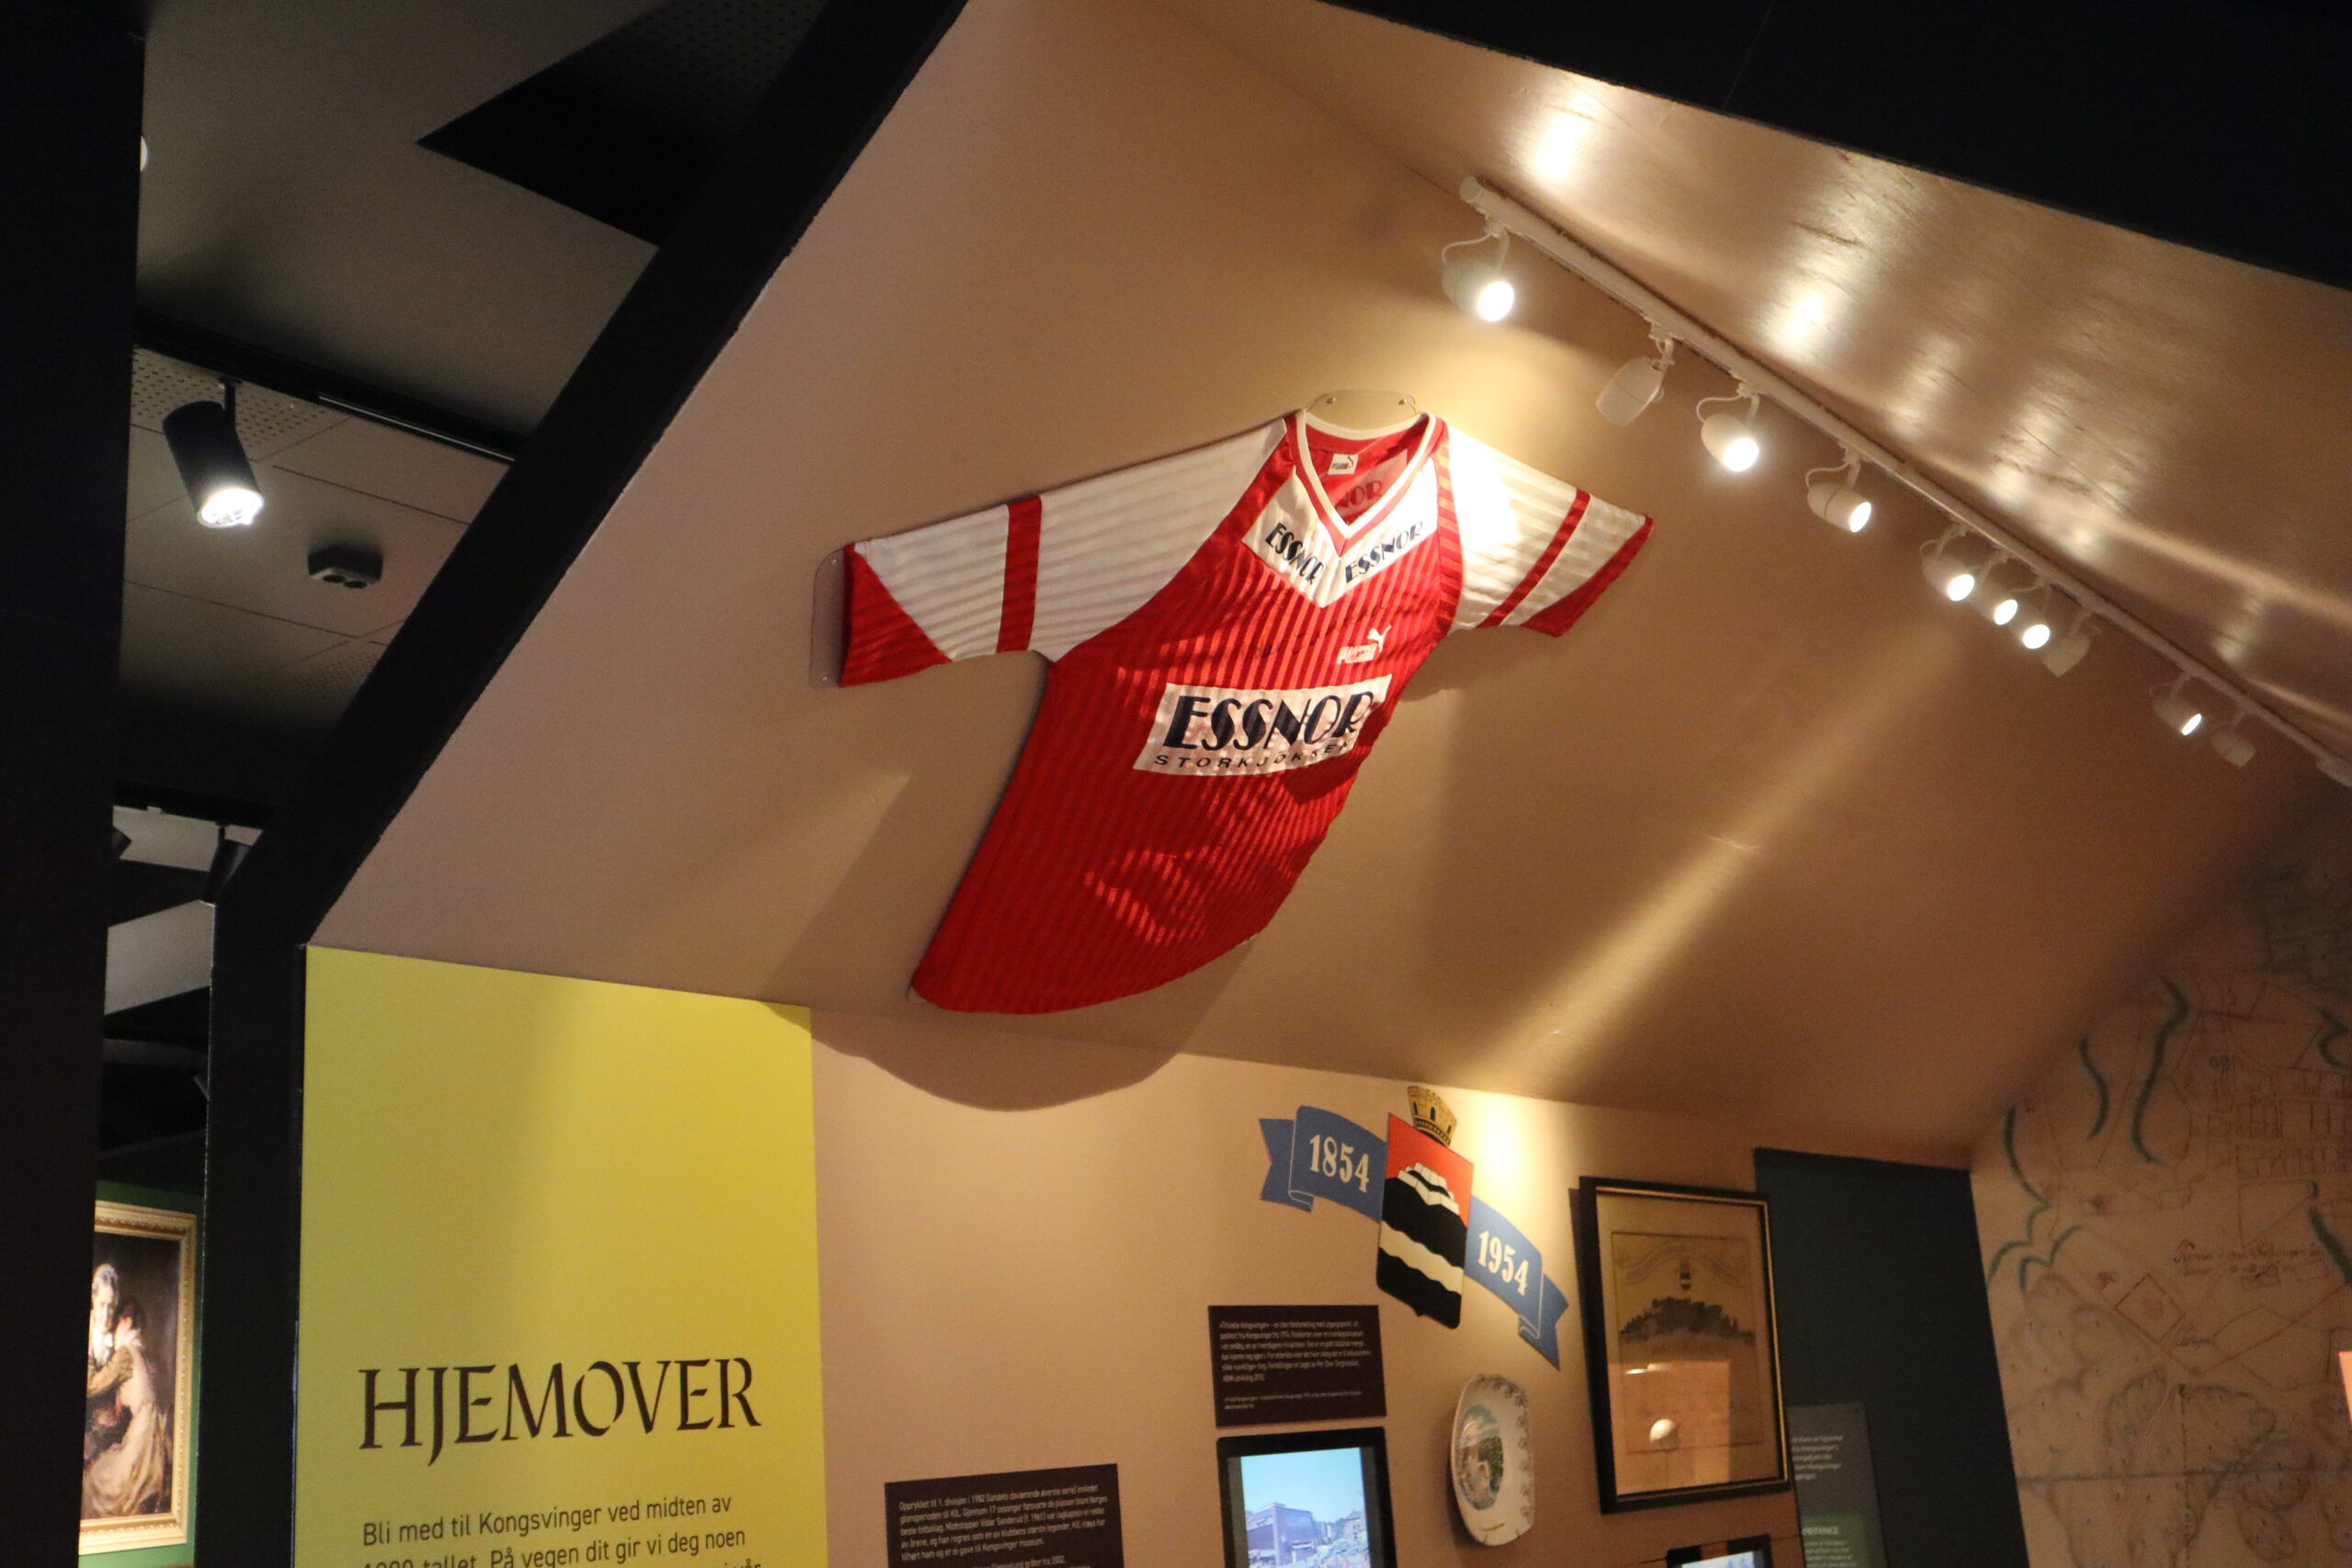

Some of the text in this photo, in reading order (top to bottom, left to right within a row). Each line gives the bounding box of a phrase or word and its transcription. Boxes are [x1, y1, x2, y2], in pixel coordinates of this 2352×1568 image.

[1265, 522, 1324, 585] ESSNOR
[1345, 521, 1423, 583] ESSNOR
[1162, 691, 1374, 751] ESSNOR
[1309, 1134, 1370, 1193] 1854
[1477, 1230, 1530, 1296] 1954
[358, 1357, 762, 1467] HJEMOVER
[363, 1495, 732, 1547] Bli med til Kongsvinger ved midten av
[491, 1547, 514, 1568] På
[521, 1547, 579, 1568] vegen
[585, 1540, 609, 1562] dit
[616, 1537, 641, 1564] gir
[647, 1534, 662, 1555] vi
[668, 1532, 699, 1556] deg
[705, 1529, 746, 1550] noen
